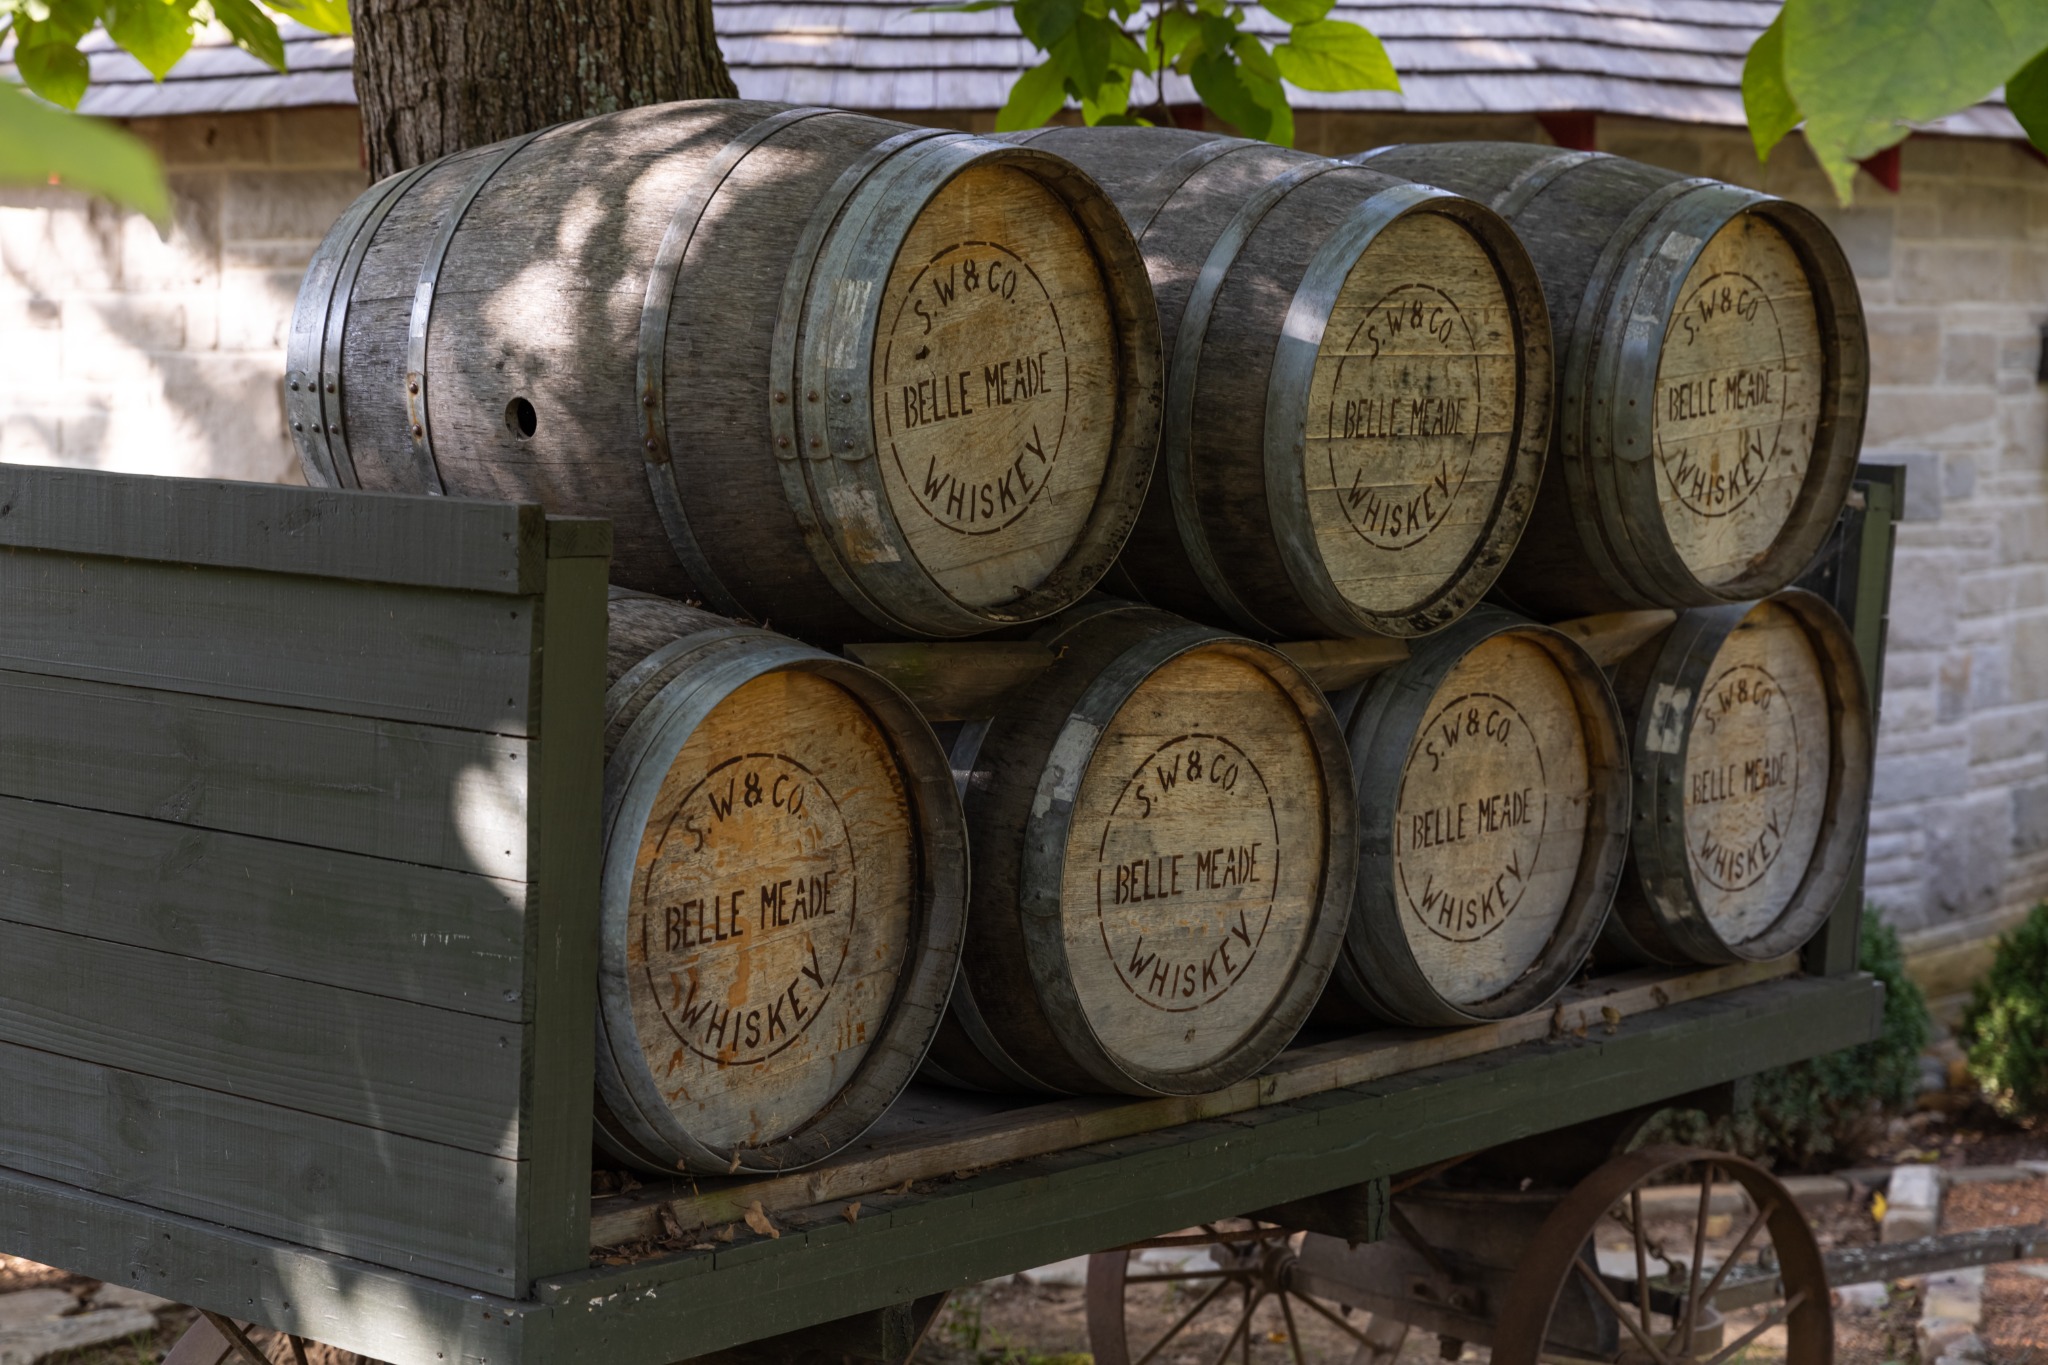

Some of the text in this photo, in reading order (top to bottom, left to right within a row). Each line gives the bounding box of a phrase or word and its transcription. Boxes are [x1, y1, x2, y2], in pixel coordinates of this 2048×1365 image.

[903, 371, 973, 428] BELLE
[984, 352, 1052, 408] MEADE
[1344, 398, 1467, 439] BELLE MEADE
[1669, 369, 1774, 422] BELLE MEADE
[924, 425, 1047, 522] WHISKEY
[1348, 460, 1449, 537] WHISKEY
[1676, 428, 1764, 506] WHISKEY
[1692, 752, 1787, 804] BELLE MEADE
[1413, 788, 1532, 850] BELLE MEADE
[1701, 808, 1782, 881] WHISKEY
[666, 870, 836, 952] BELLE MEADE
[1115, 843, 1262, 904] BELLE MEADE
[1422, 849, 1521, 931] WHISKEY
[1129, 909, 1251, 999] WHISKEY
[681, 946, 824, 1051] WHISKEY
